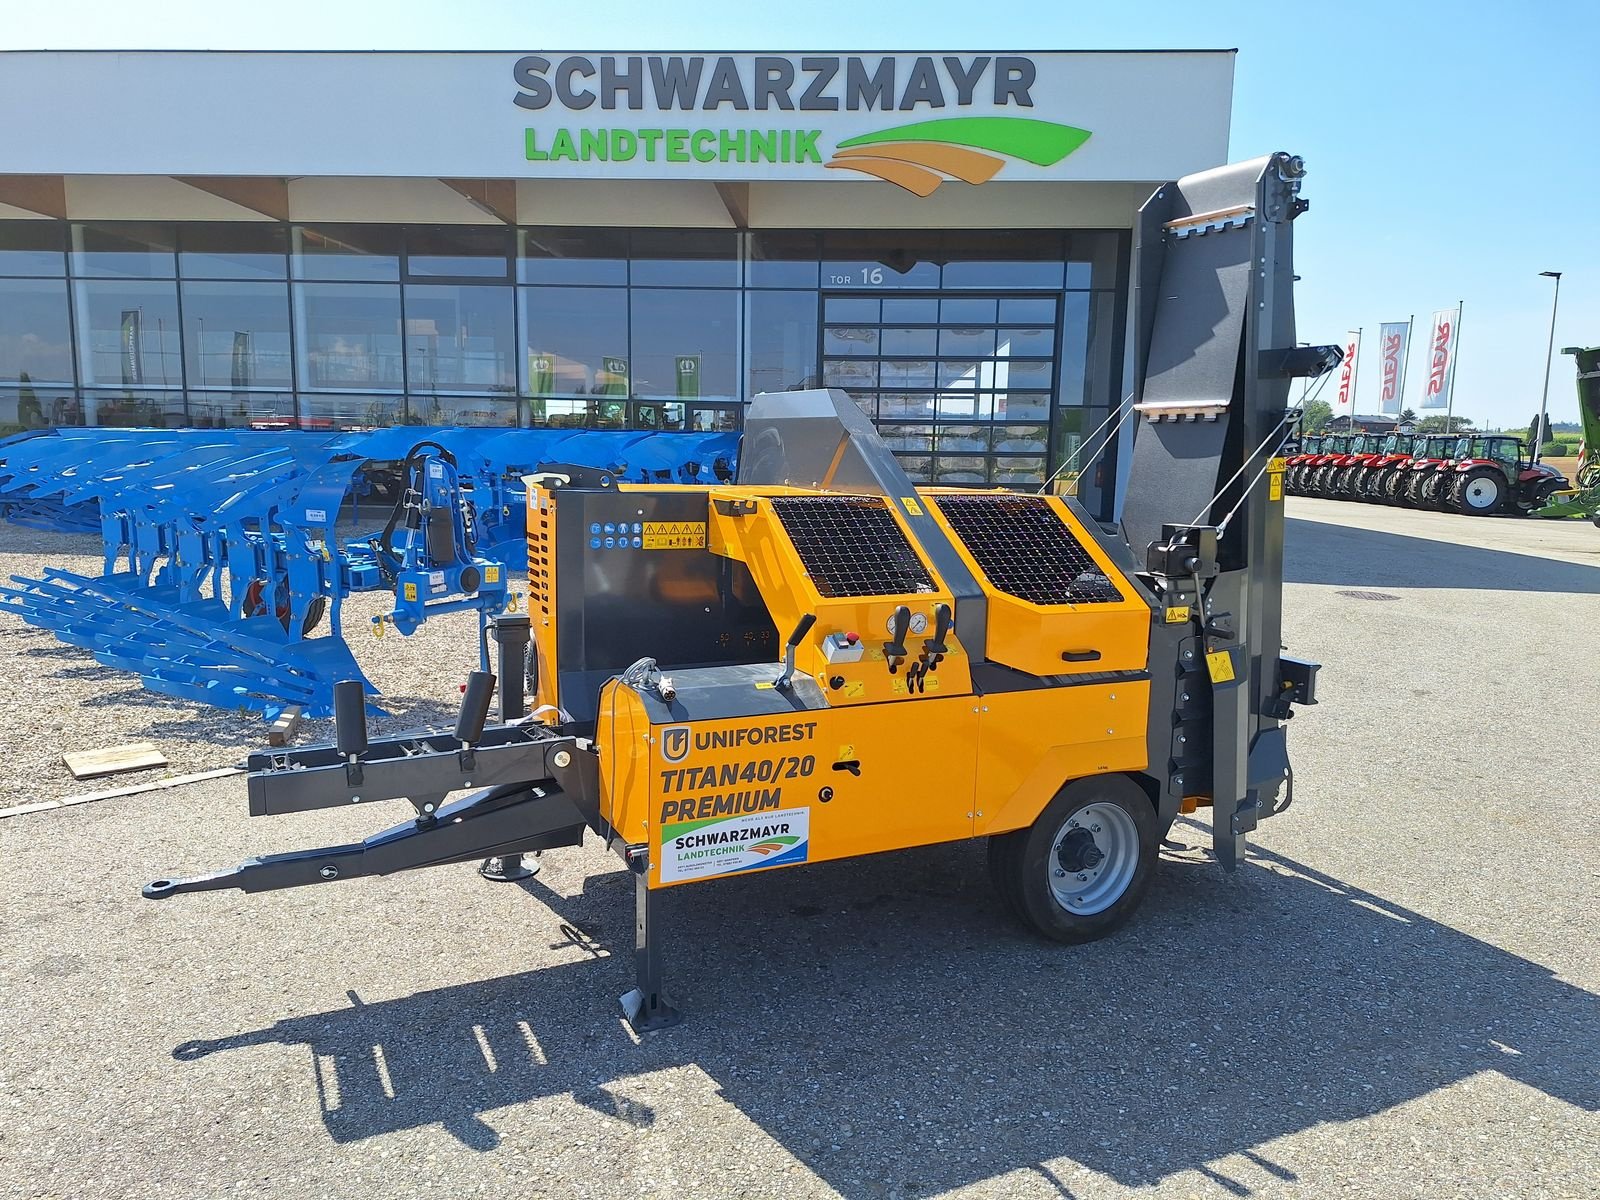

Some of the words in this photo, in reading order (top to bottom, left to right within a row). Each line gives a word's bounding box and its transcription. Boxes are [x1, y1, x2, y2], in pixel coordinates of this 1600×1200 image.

[513, 55, 1037, 112] SCHWARZMAYR
[525, 127, 823, 164] LANDTECHNIK
[830, 275, 851, 285] TOR
[861, 267, 884, 285] 16
[695, 722, 817, 750] UNIFOREST
[660, 787, 782, 824] PREMIUM
[675, 823, 790, 850] SCHWARZMAYR
[677, 844, 745, 861] LANDTECHNIK
